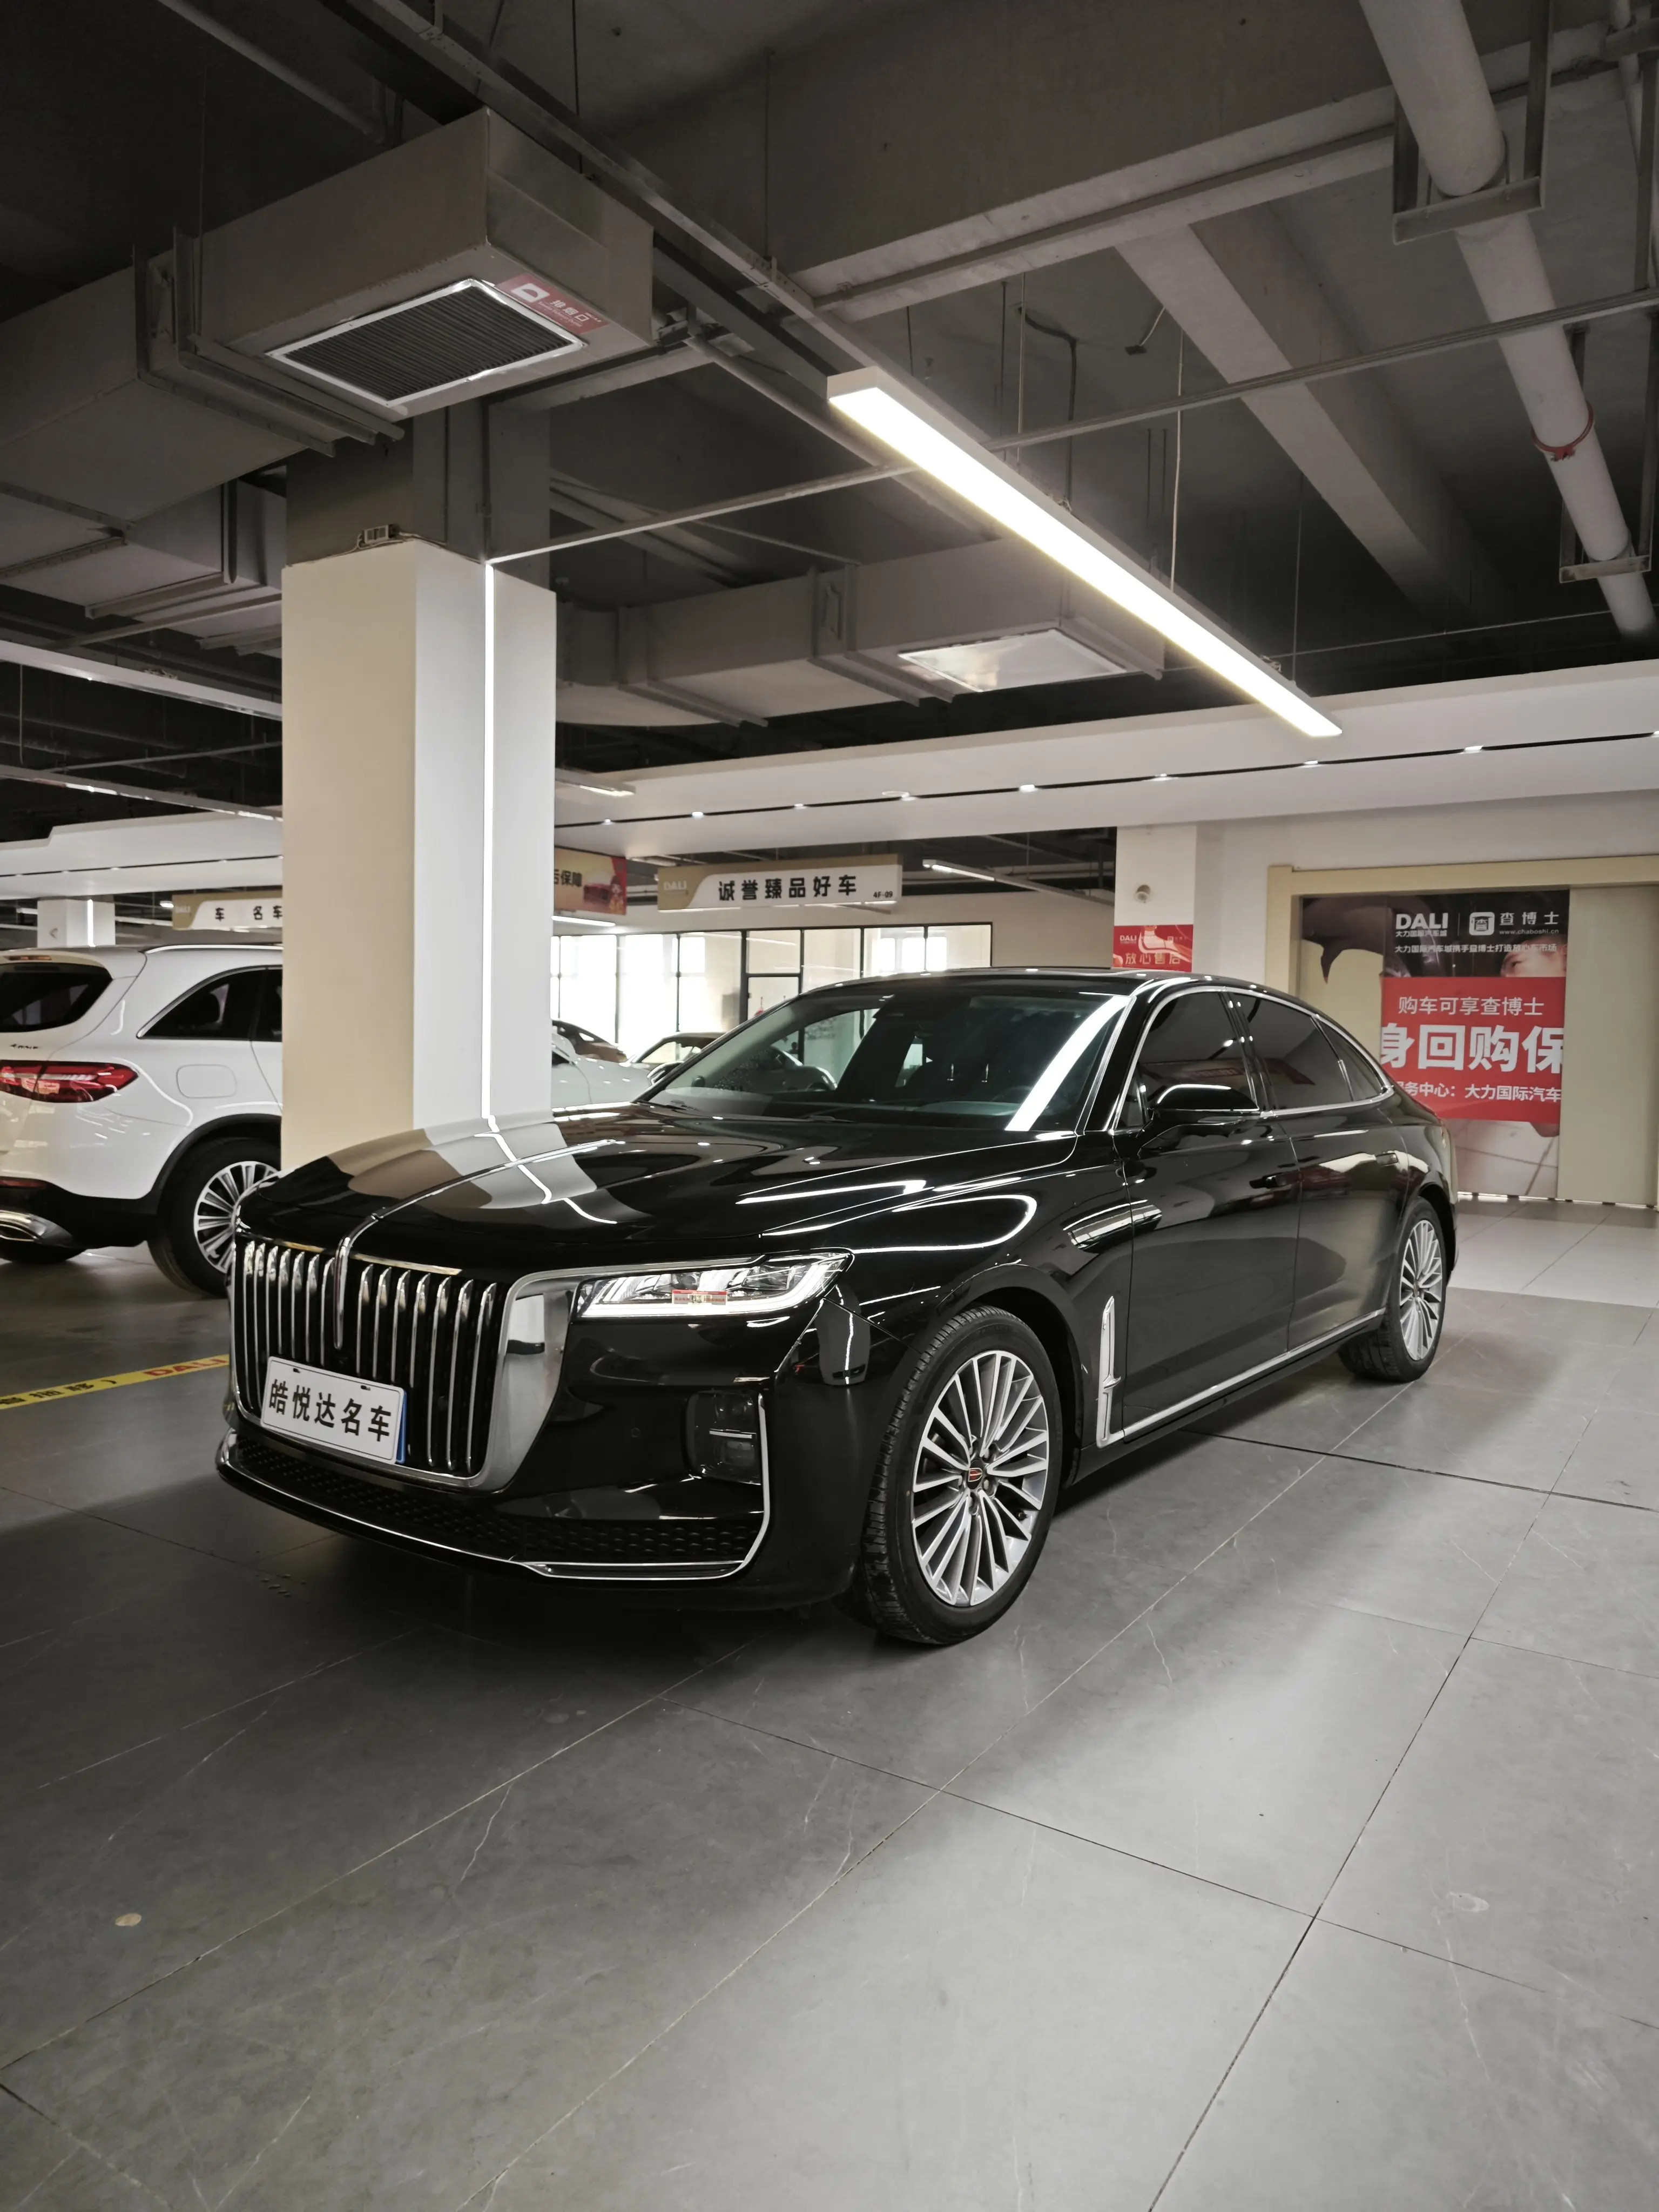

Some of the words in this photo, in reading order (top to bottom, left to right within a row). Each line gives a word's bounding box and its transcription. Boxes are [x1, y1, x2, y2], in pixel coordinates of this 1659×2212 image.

[718, 874, 857, 901] 诚誉臻品好车
[873, 891, 893, 899] 4F-09
[1396, 912, 1449, 930] DALI
[1499, 912, 1559, 926] 查博士
[1398, 996, 1545, 1016] 购车可享查博士
[1380, 1022, 1563, 1074] 身回购保
[143, 1358, 228, 1376] DALI
[269, 1379, 392, 1441] 皓悦达名车
